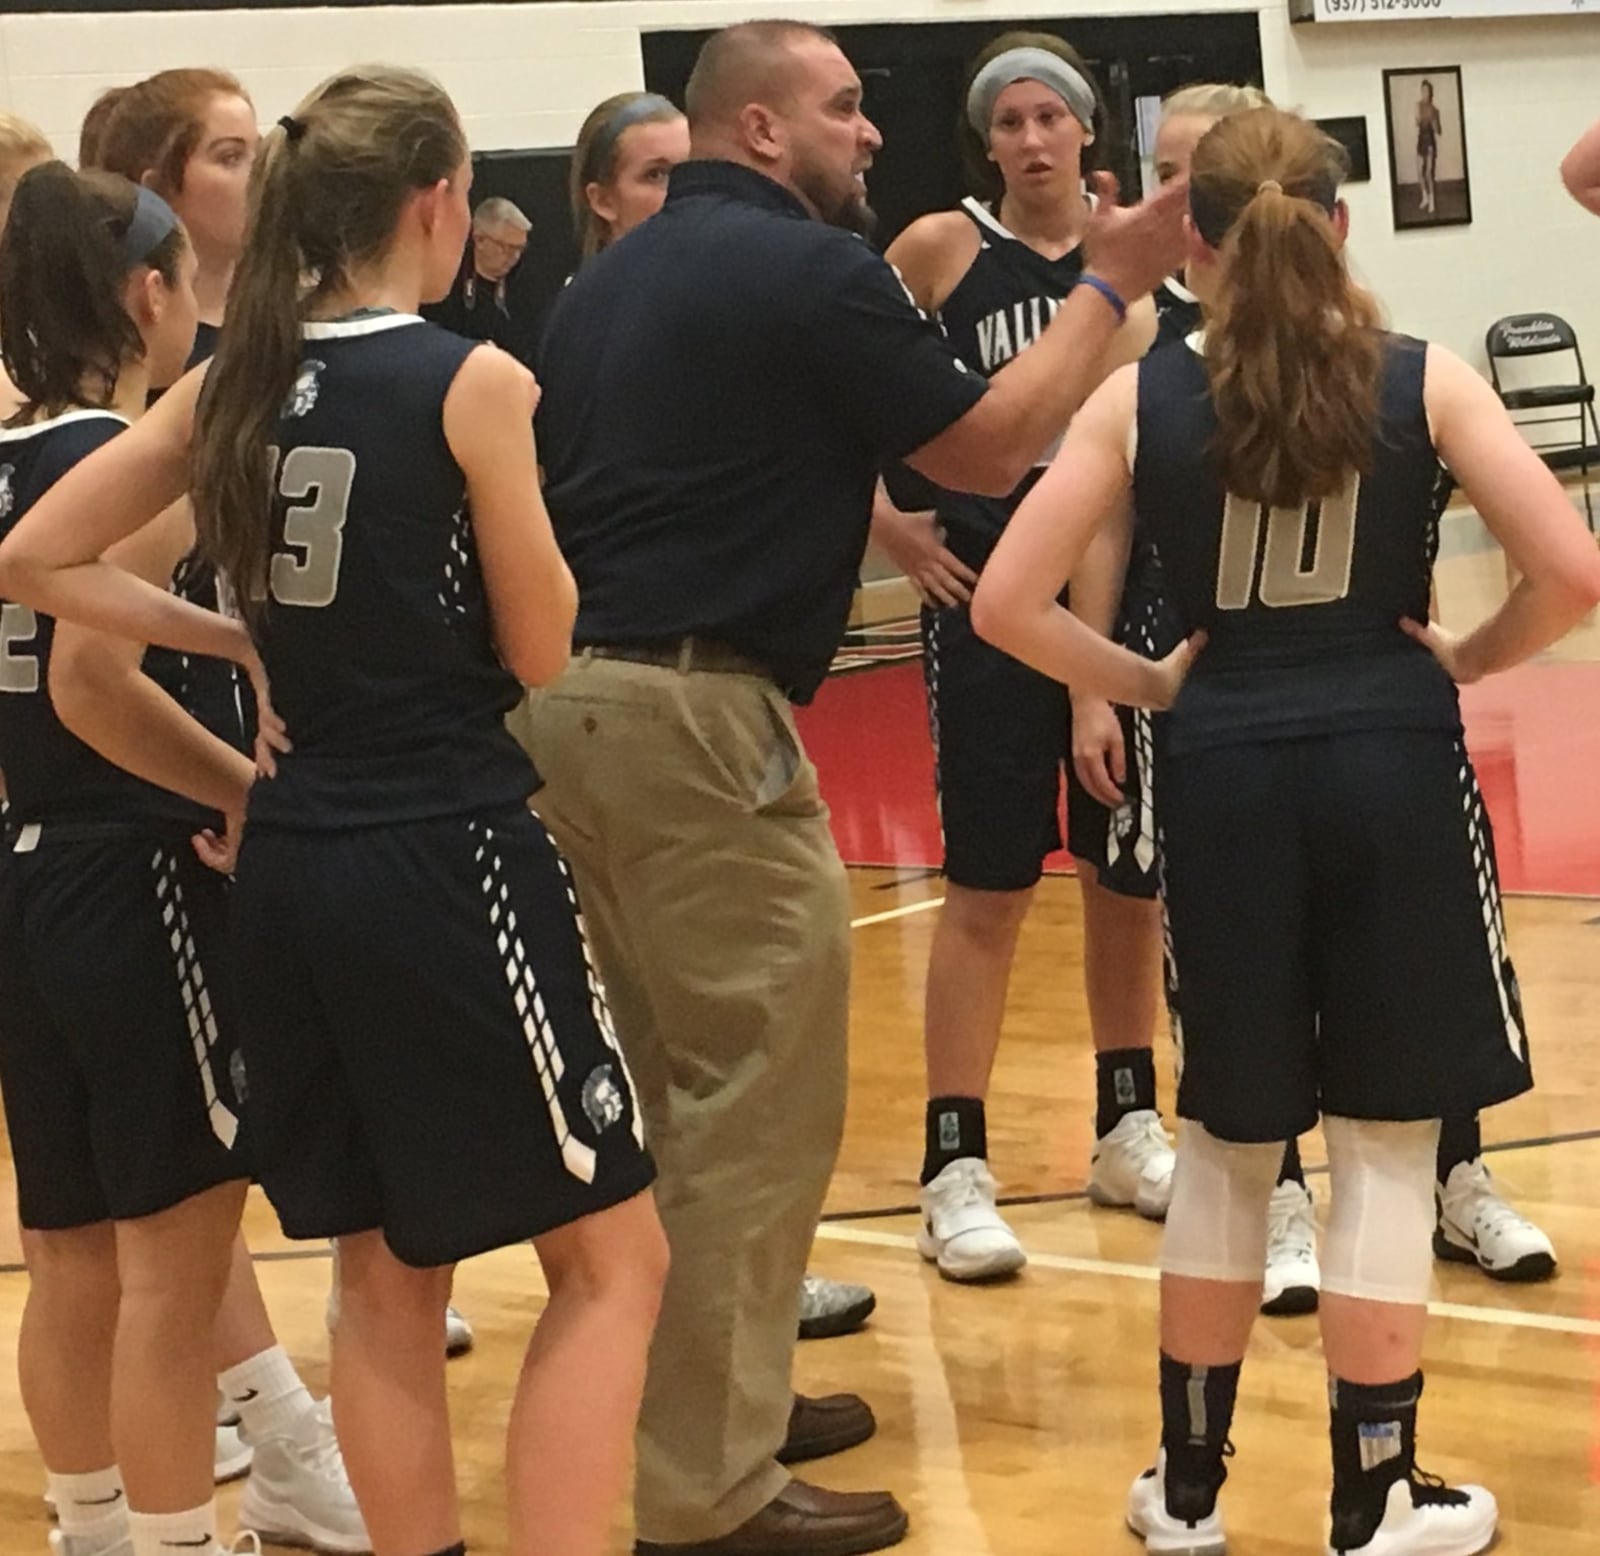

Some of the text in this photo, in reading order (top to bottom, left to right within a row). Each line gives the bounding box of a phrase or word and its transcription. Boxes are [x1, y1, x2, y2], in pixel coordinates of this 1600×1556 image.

[976, 296, 1067, 370] VALL
[250, 445, 356, 607] 3
[1216, 470, 1360, 609] 10
